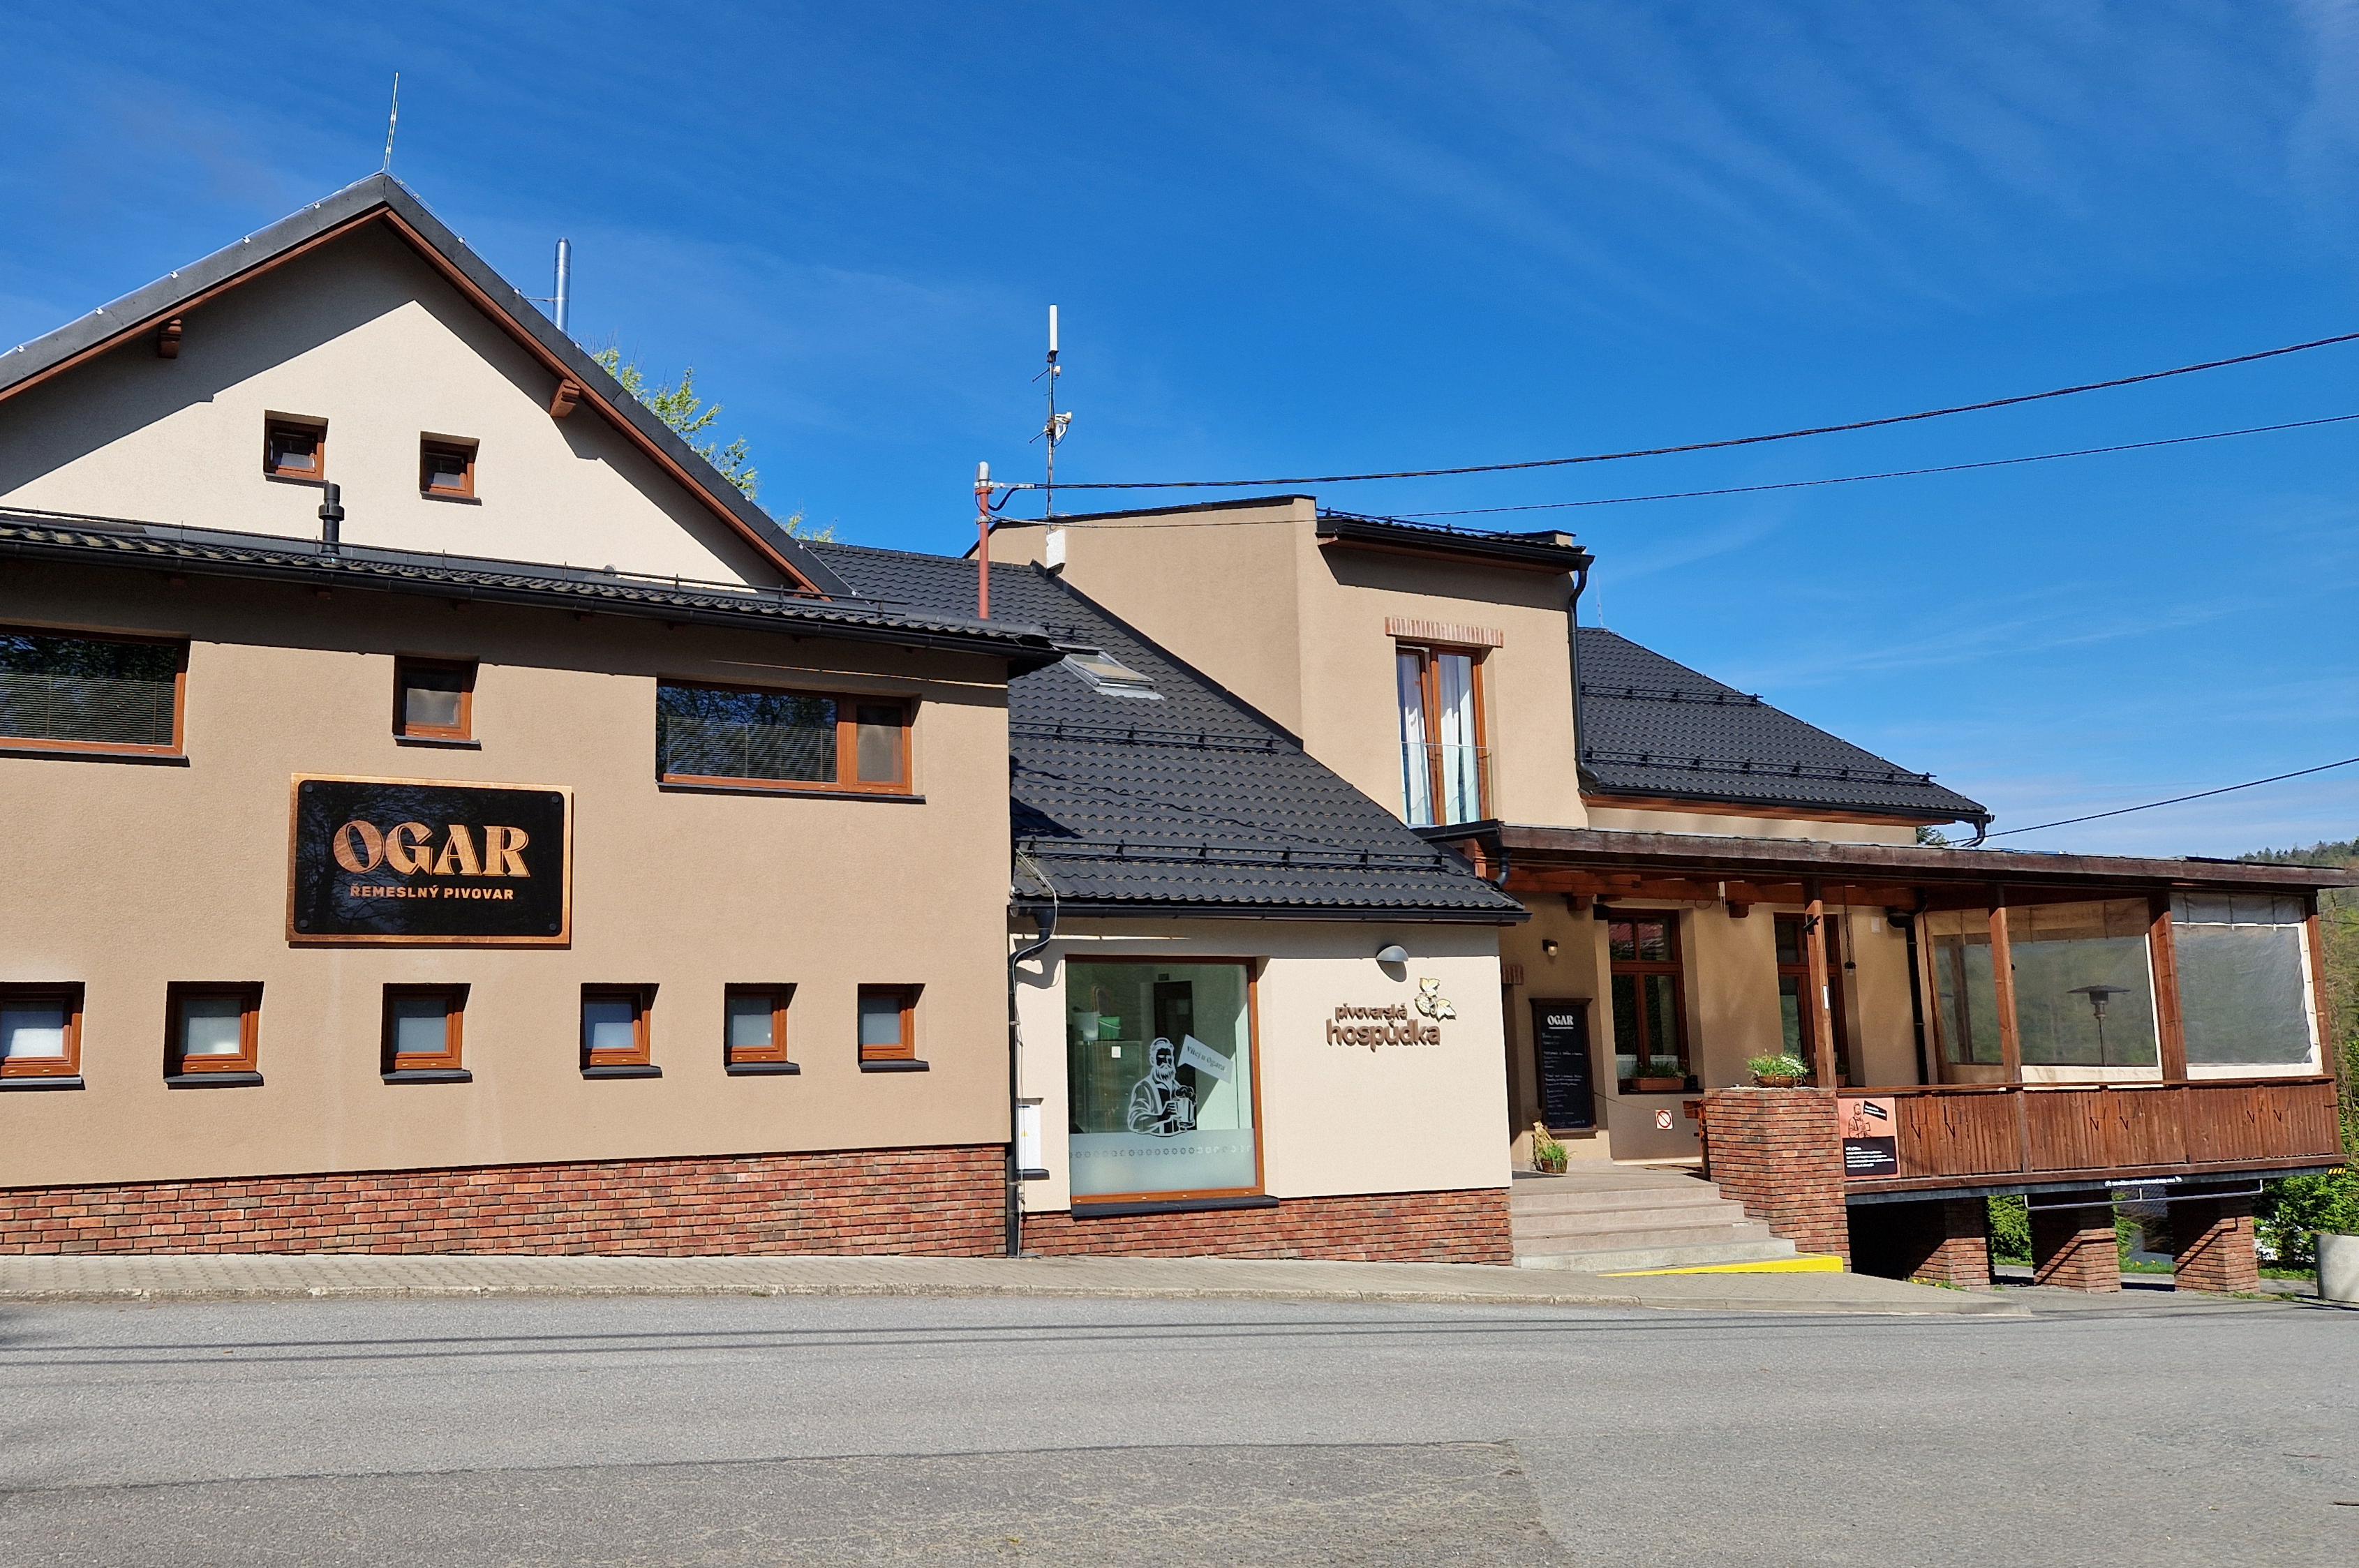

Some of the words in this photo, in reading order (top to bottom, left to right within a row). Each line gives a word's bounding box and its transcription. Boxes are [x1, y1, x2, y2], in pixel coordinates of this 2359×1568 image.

[333, 819, 530, 877] OGAR
[350, 883, 438, 898] ŘEMESLNÝ
[444, 887, 514, 900] PIVOVAR
[1335, 1003, 1408, 1023] pivovarská
[1547, 1015, 1574, 1026] OGAR
[1326, 1018, 1441, 1052] hospůdka
